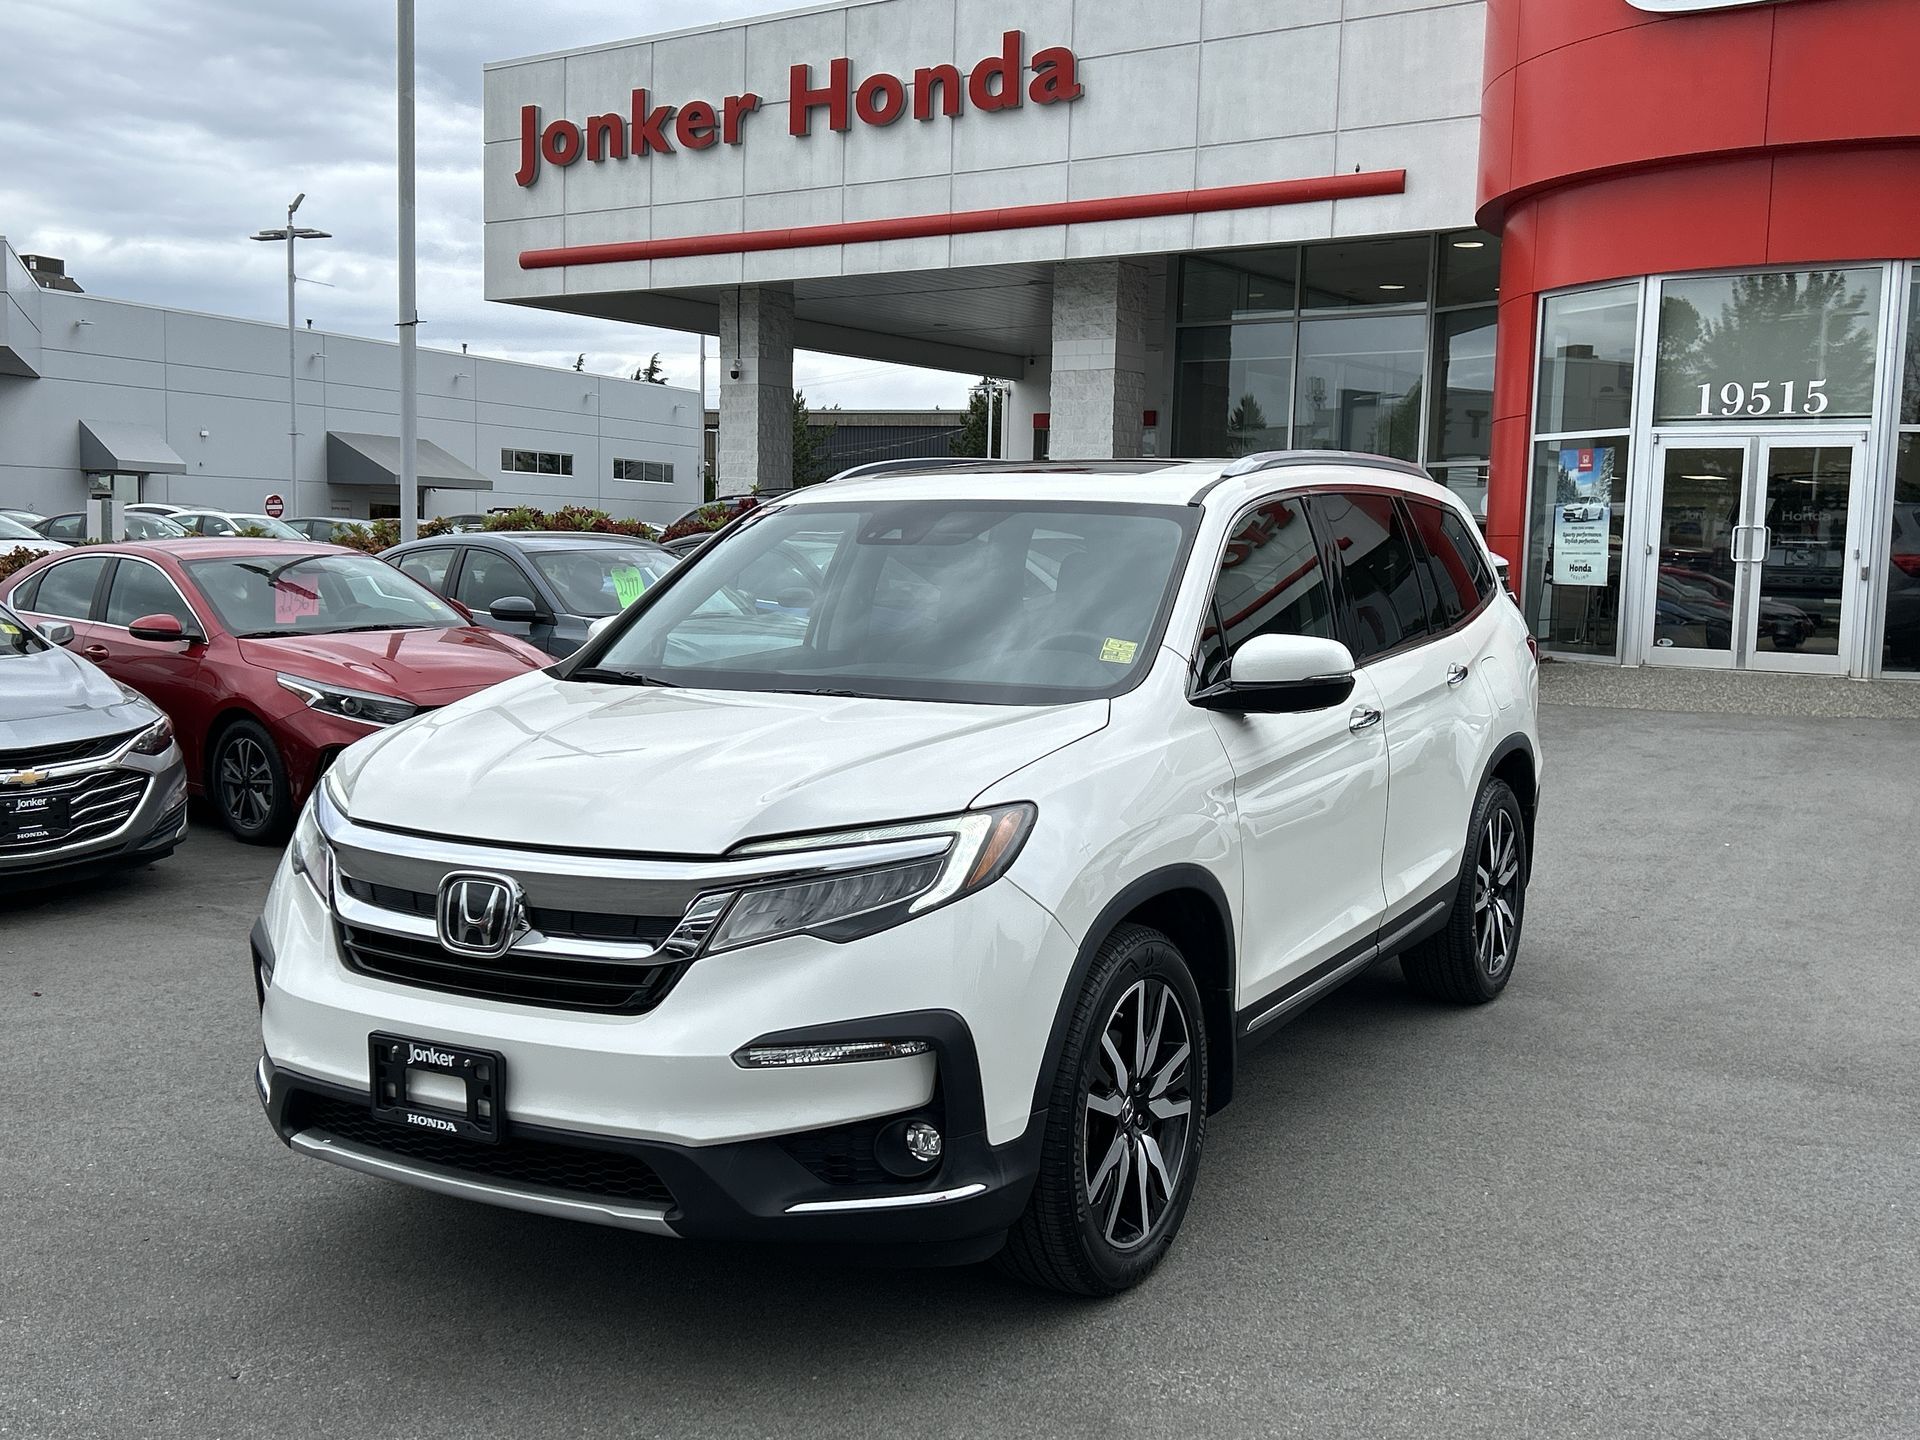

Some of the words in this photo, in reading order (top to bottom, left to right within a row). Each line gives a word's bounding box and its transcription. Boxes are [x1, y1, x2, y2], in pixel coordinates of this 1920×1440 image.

[514, 88, 762, 187] Jonker
[789, 30, 1085, 137] Honda
[1696, 378, 1828, 416] 19515
[1569, 563, 1592, 573] Honda
[16, 798, 47, 811] Jonker
[17, 830, 49, 839] HONDA
[407, 1043, 455, 1067] Jonker
[407, 1113, 457, 1133] HONDA
